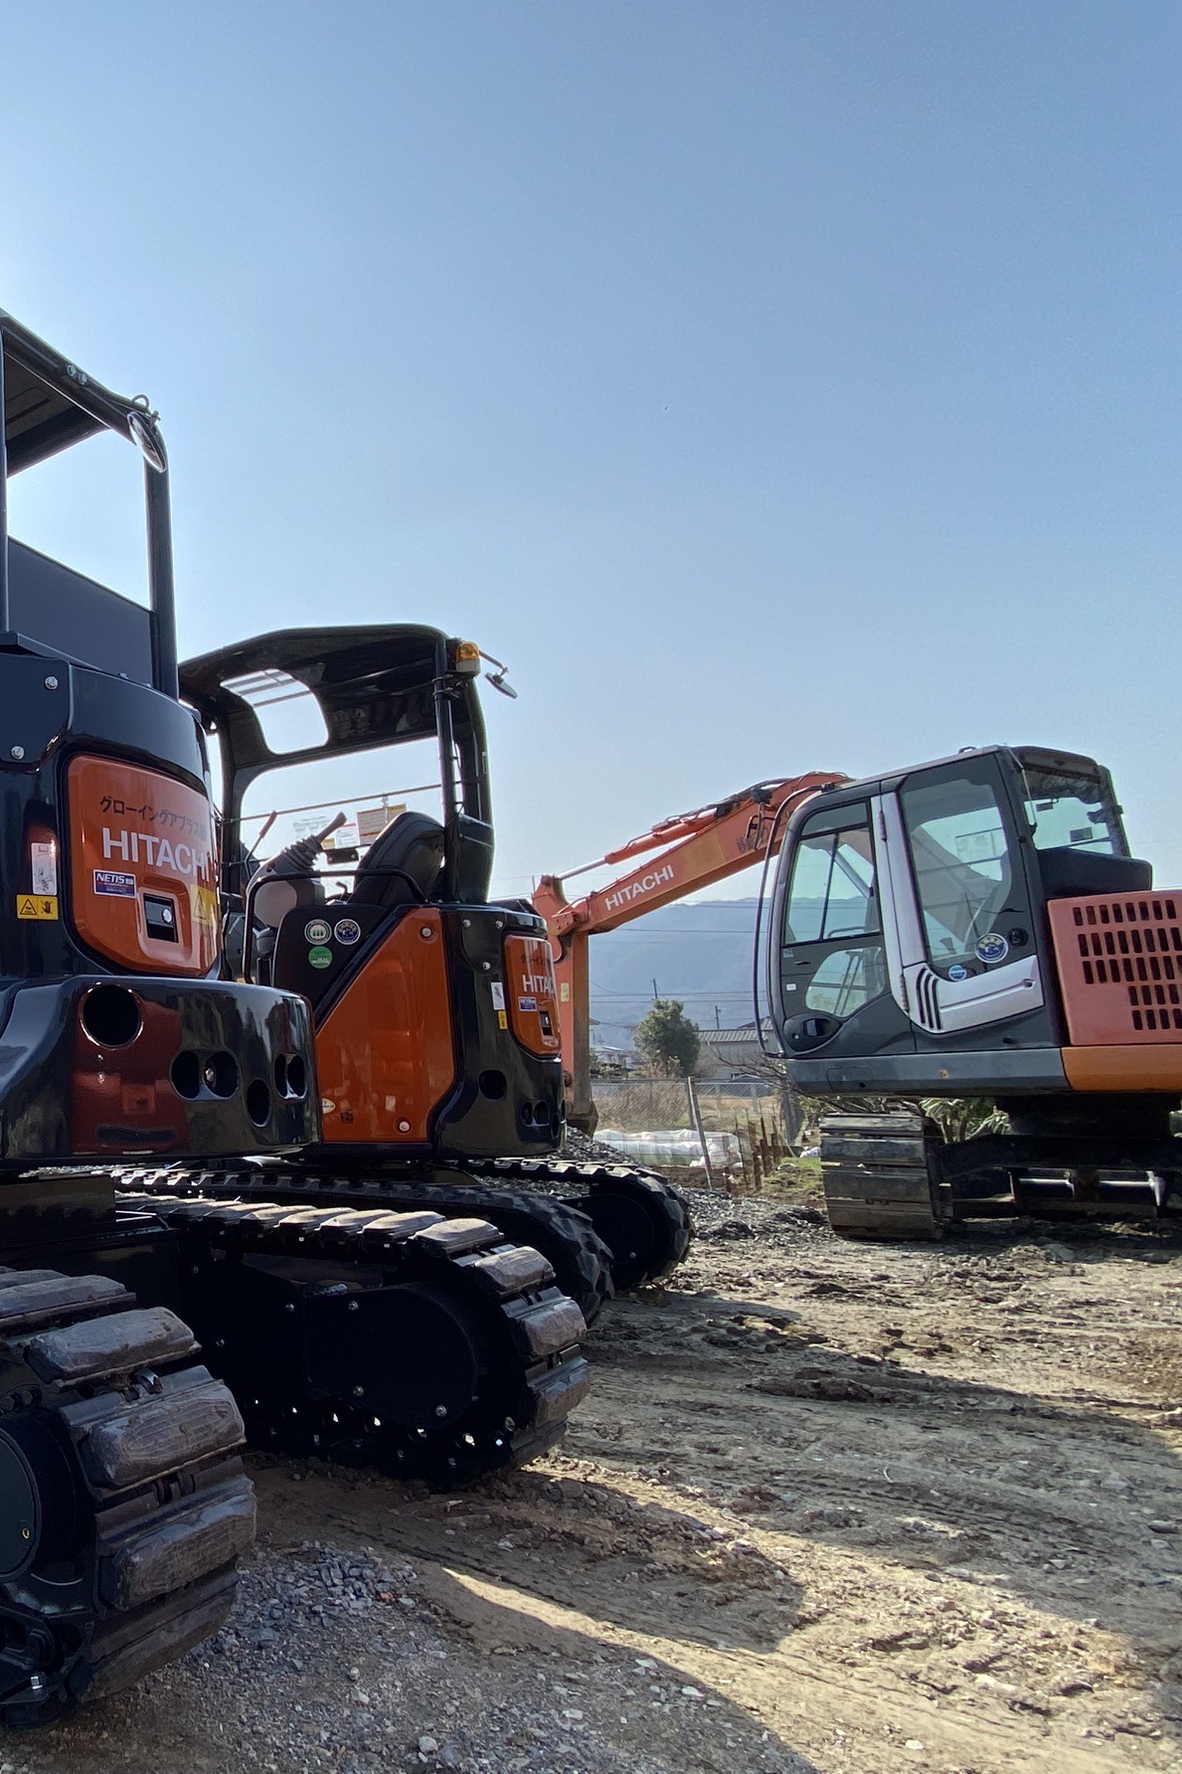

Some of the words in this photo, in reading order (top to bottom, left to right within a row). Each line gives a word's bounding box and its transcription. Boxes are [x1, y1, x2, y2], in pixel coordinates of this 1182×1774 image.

[96, 872, 125, 884] NETIS
[102, 827, 210, 883] HITACHI
[604, 864, 675, 911] HITACHI
